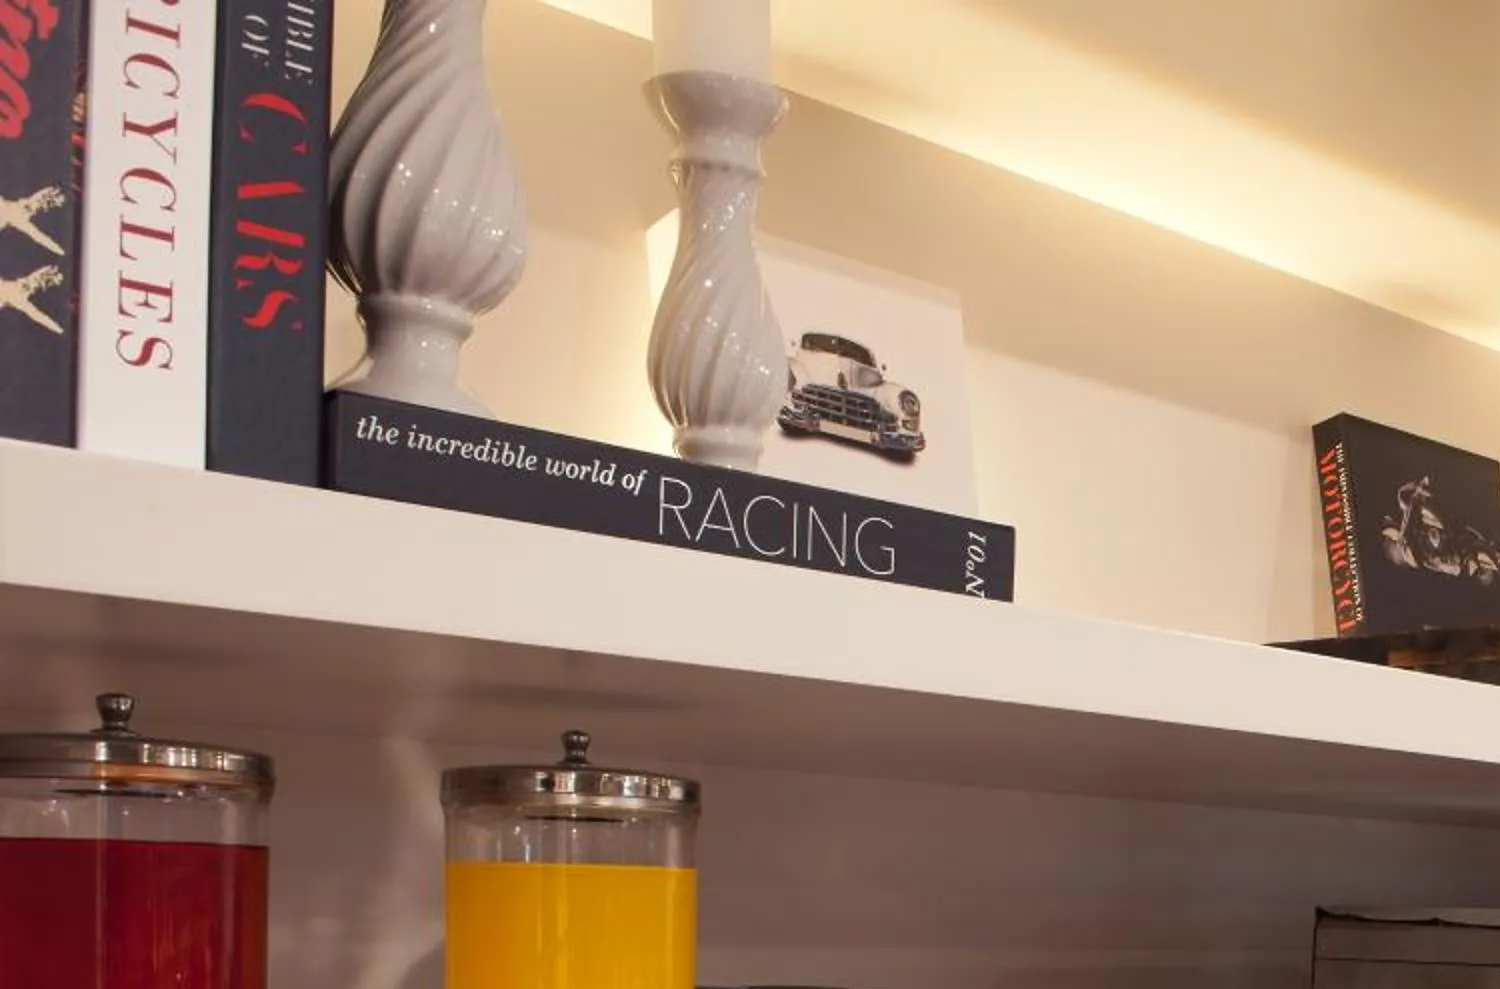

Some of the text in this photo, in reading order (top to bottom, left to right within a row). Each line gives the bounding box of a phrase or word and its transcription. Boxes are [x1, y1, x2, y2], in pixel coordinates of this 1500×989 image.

[241, 14, 270, 67] OF
[284, 0, 315, 86] IBLE
[115, 0, 182, 371] ICYCLES
[234, 92, 311, 331] CARS
[355, 415, 648, 497] the incredible world of
[657, 475, 897, 576] RACING
